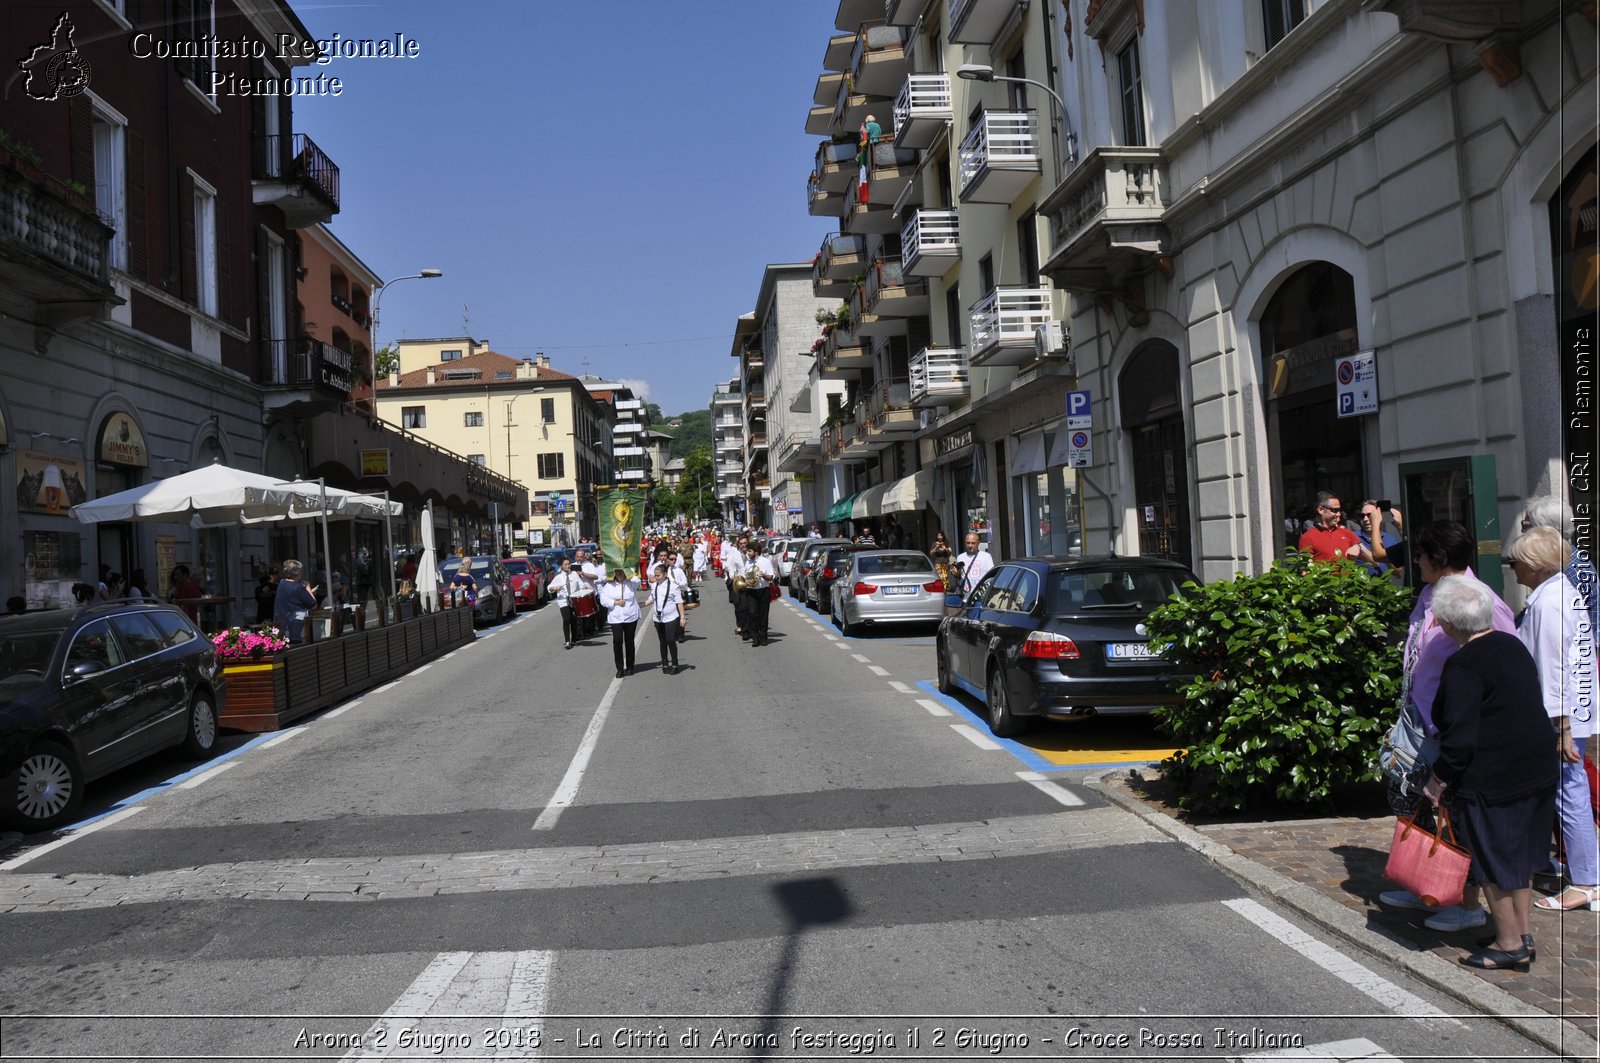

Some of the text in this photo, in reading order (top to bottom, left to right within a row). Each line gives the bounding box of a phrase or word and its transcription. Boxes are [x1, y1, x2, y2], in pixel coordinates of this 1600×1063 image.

[1070, 393, 1086, 415] P
[1342, 395, 1351, 412] P
[108, 440, 141, 457] JIMMY'S
[1114, 643, 1128, 656] CT
